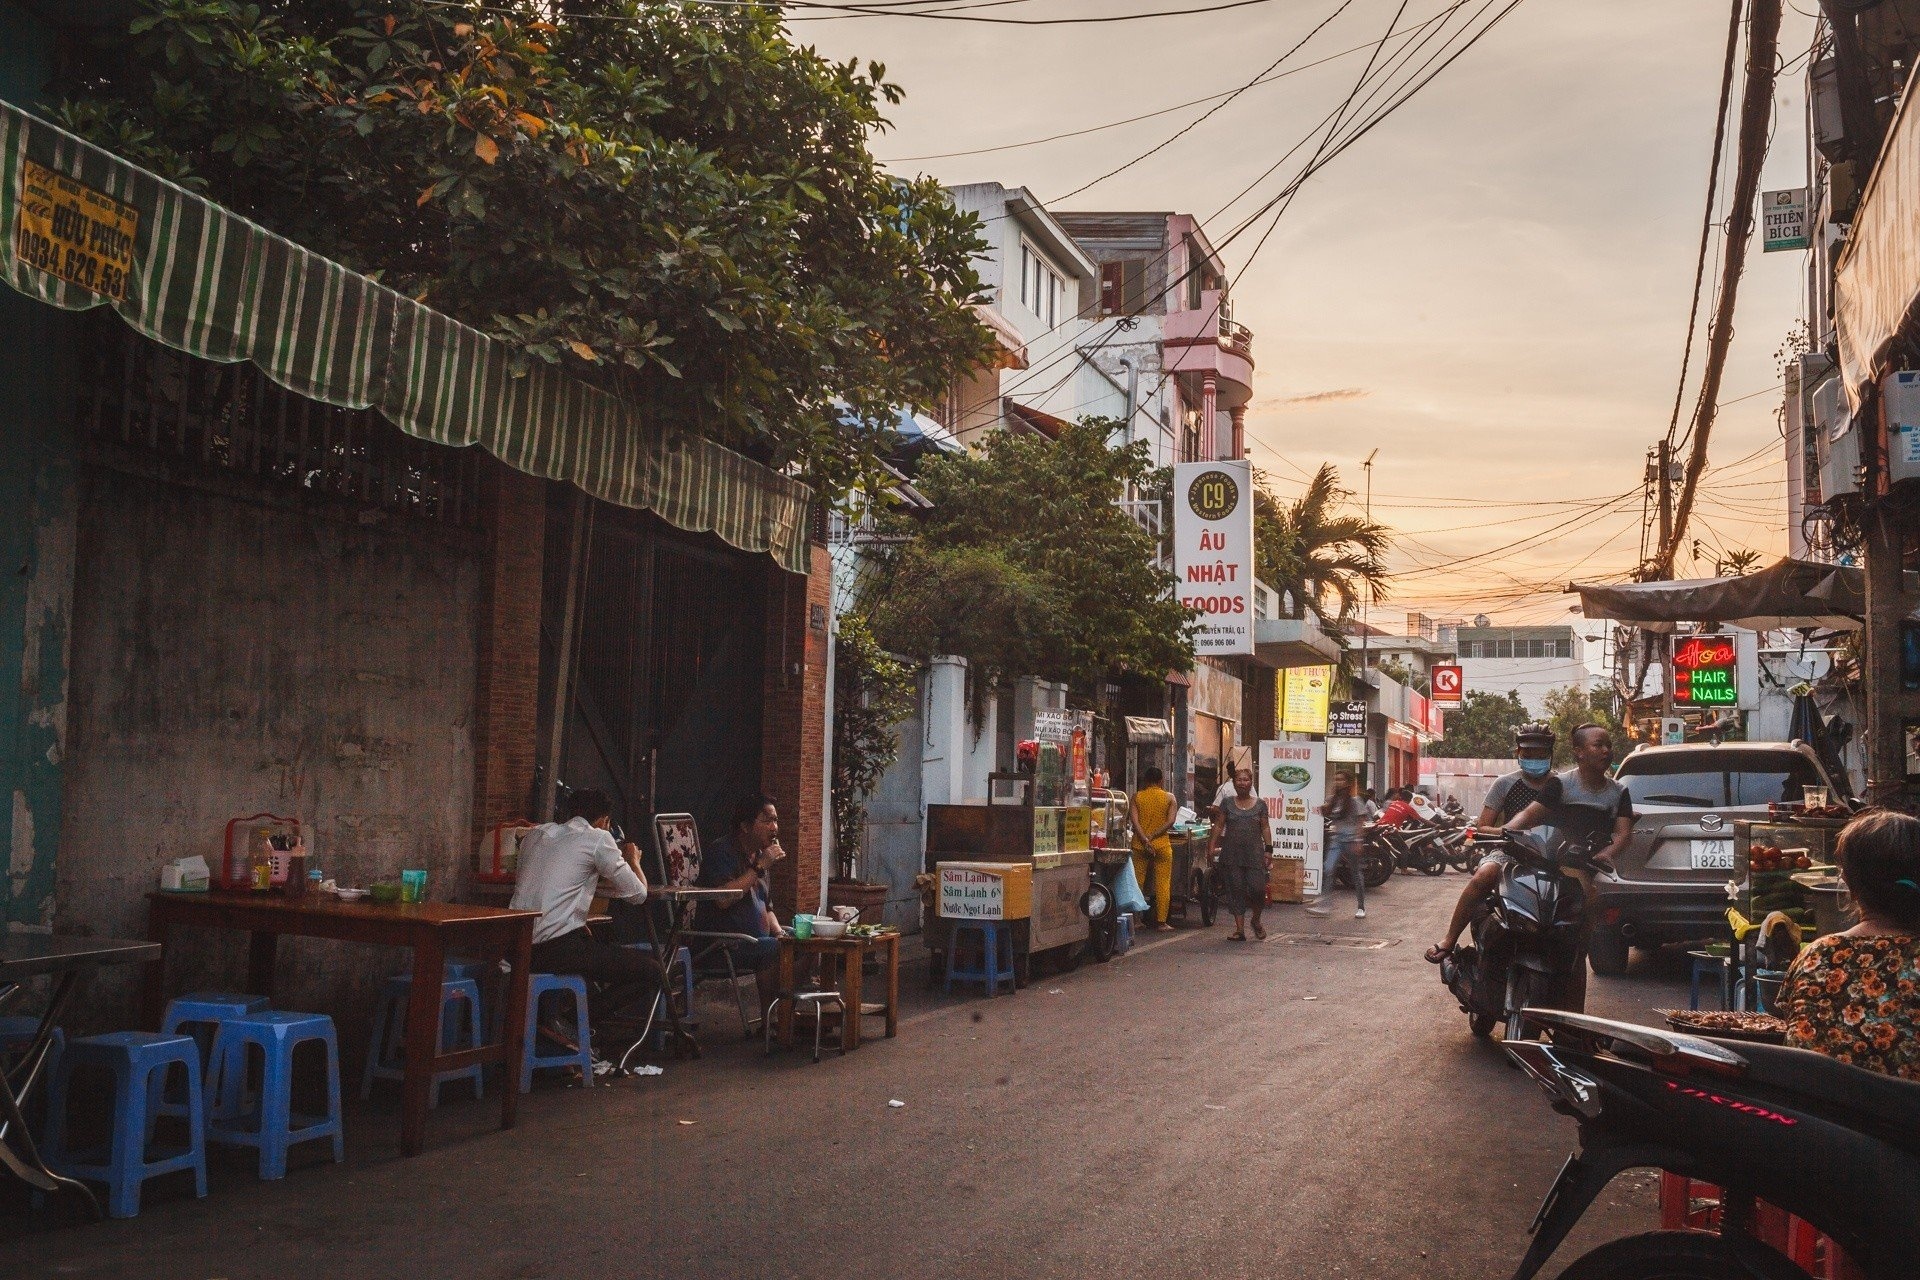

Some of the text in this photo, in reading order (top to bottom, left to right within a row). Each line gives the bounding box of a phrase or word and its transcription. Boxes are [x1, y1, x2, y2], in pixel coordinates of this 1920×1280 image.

[1765, 210, 1804, 226] THIÊN
[1770, 225, 1801, 239] BÍCH
[1220, 474, 1236, 494] Foods
[1204, 483, 1224, 508] C9
[1192, 503, 1216, 518] Western
[1199, 528, 1226, 550] ÂU
[1187, 560, 1238, 586] NHẬT
[1182, 596, 1245, 614] FOODS
[1676, 640, 1733, 668] Hoa
[1442, 675, 1455, 689] K
[1692, 670, 1726, 683] HAIR
[1692, 687, 1734, 700] NAILS
[1348, 703, 1365, 712] Cafe
[1340, 712, 1363, 720] Stress
[1274, 748, 1311, 760] MENU
[1701, 840, 1725, 854] 72A
[1694, 855, 1734, 868] 182.65
[944, 870, 962, 882] Sâm
[965, 872, 987, 884] Lạnh
[943, 886, 962, 897] Sâm
[964, 887, 987, 900] Lạnh
[943, 902, 1001, 917] Nước Ngọt Lạnh
[1665, 1081, 1798, 1126] VISION
